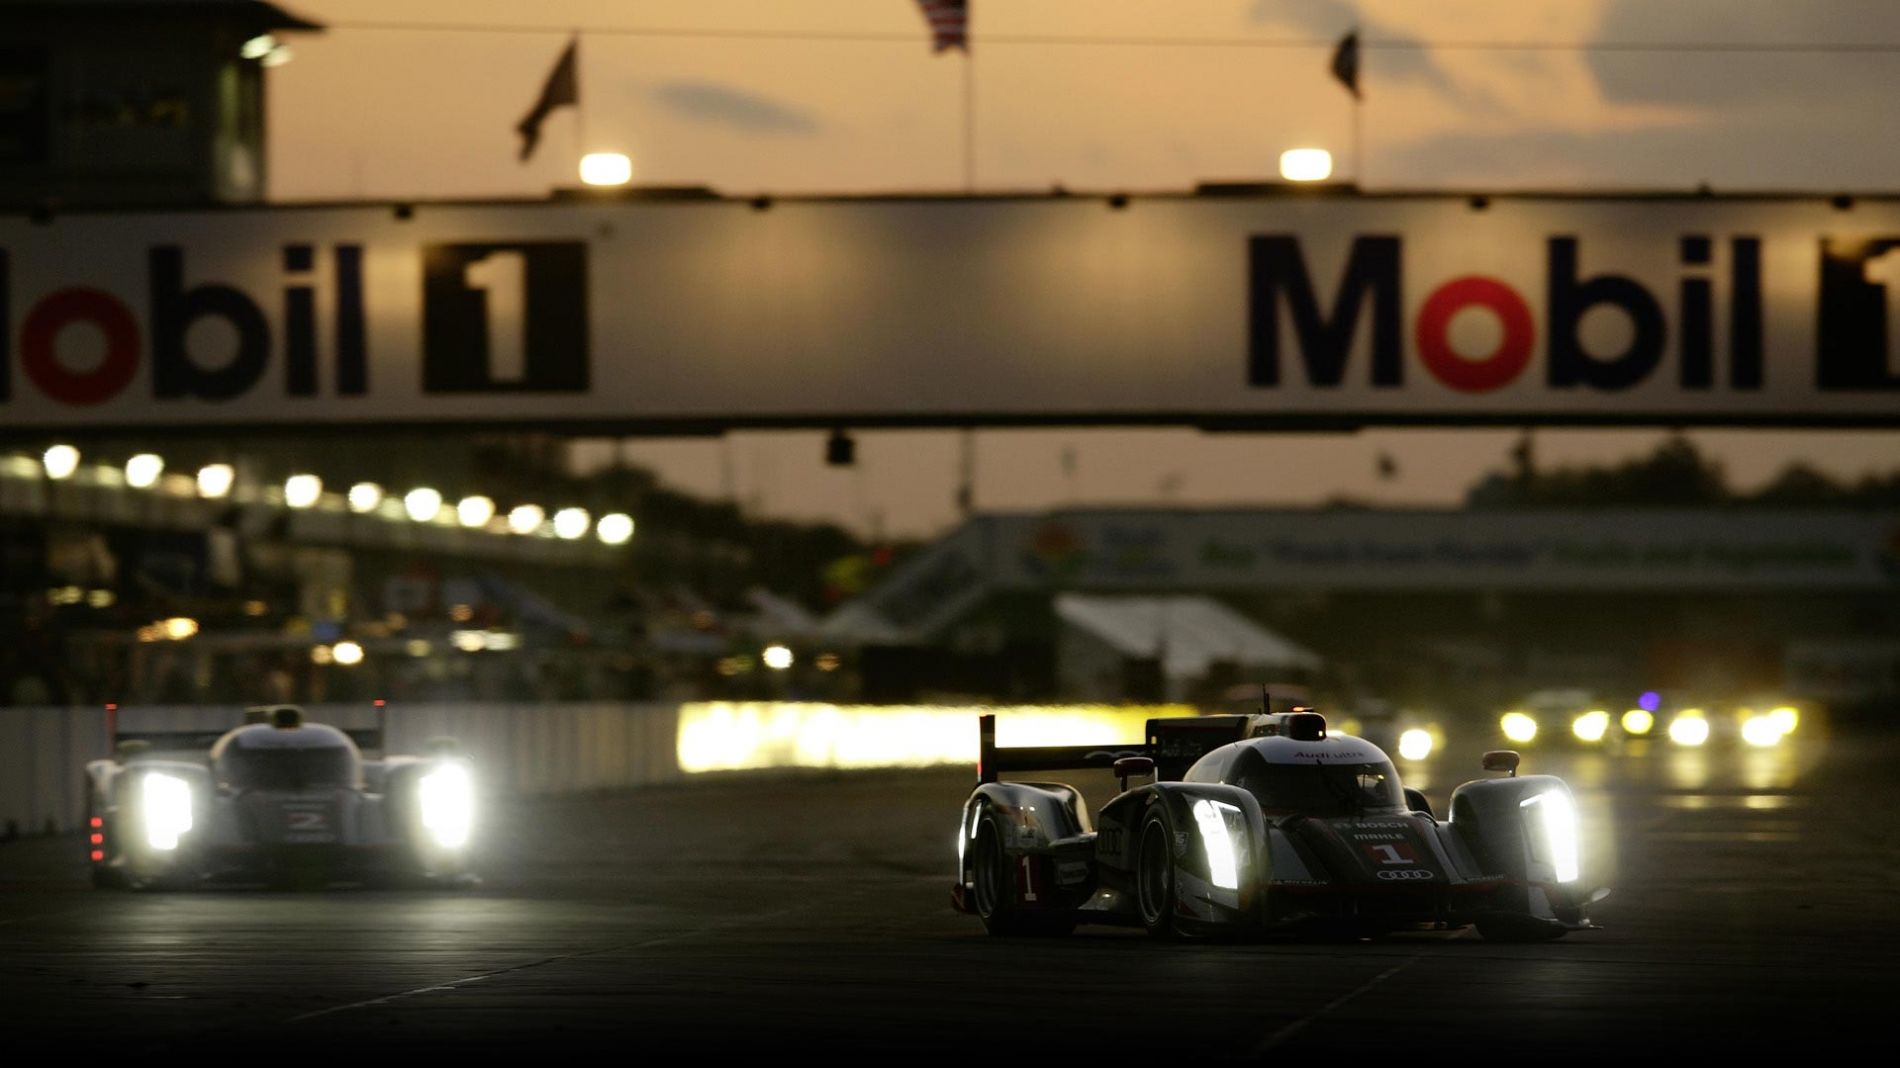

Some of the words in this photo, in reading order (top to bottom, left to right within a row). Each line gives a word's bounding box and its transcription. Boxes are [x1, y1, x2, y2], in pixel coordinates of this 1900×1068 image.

[0, 245, 366, 404] obil
[1248, 236, 1762, 393] Mobil
[1294, 751, 1329, 759] Audi
[288, 811, 328, 830] 2
[1371, 844, 1414, 864] 1
[1021, 855, 1038, 902] 1
